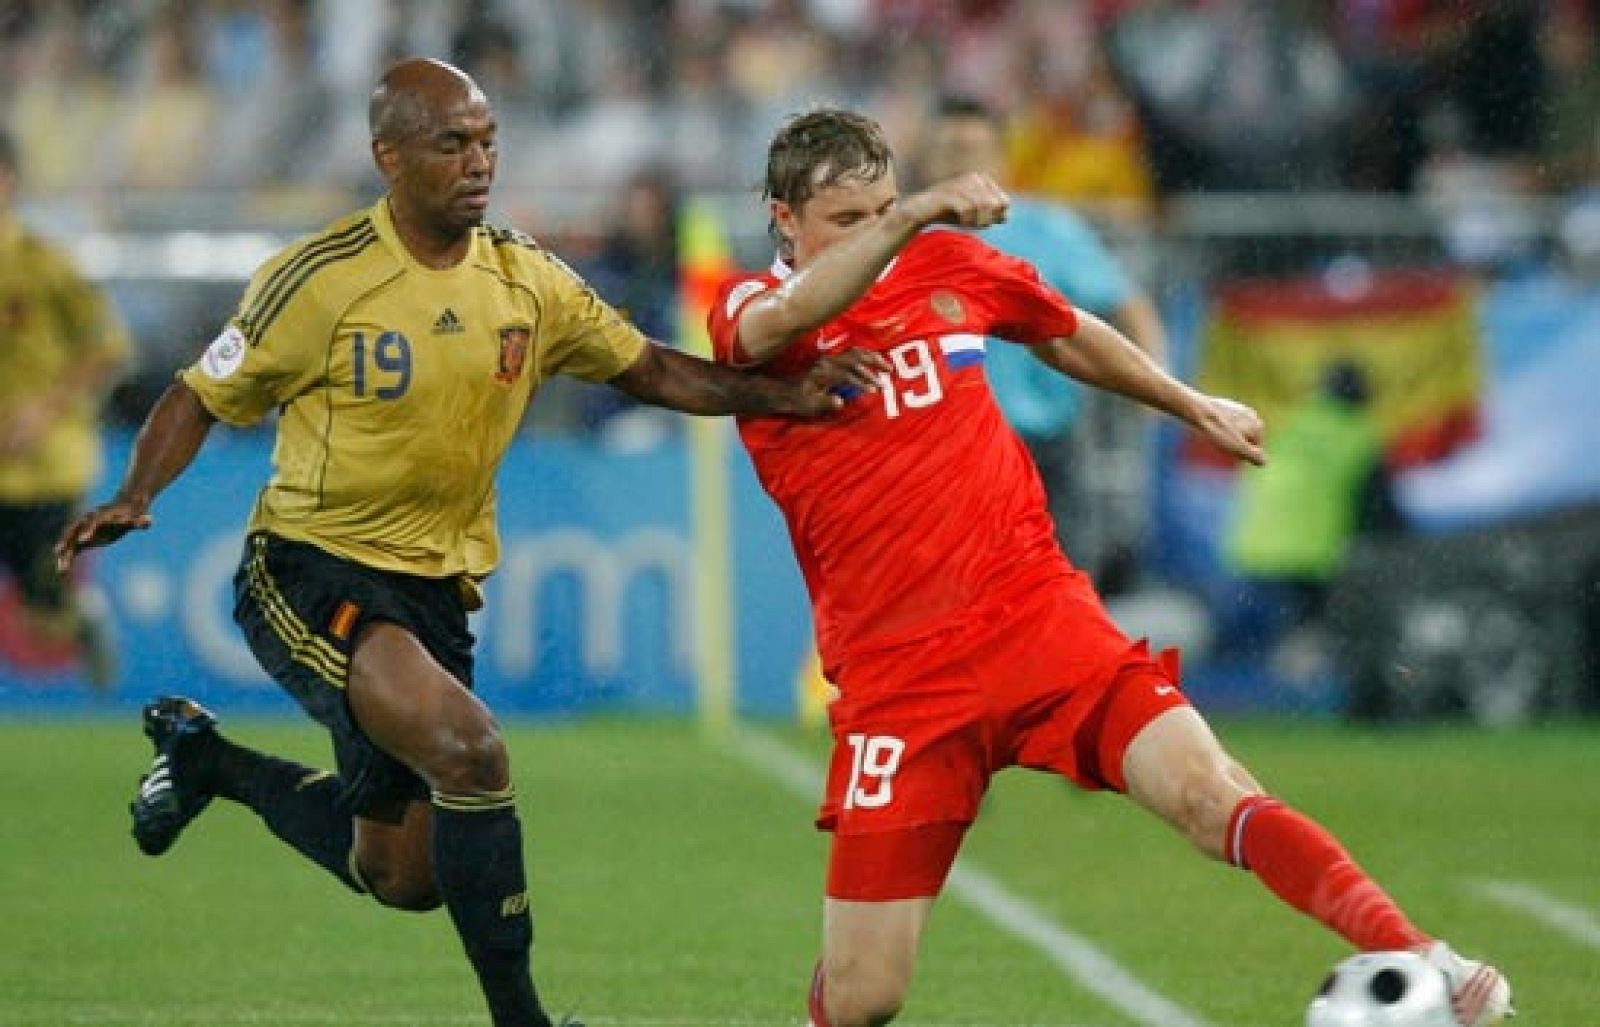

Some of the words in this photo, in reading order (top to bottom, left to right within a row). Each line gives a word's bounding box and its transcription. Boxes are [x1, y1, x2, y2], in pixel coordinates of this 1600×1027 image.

[352, 330, 412, 401] 19
[876, 339, 944, 419] 19
[843, 732, 906, 811] 19
